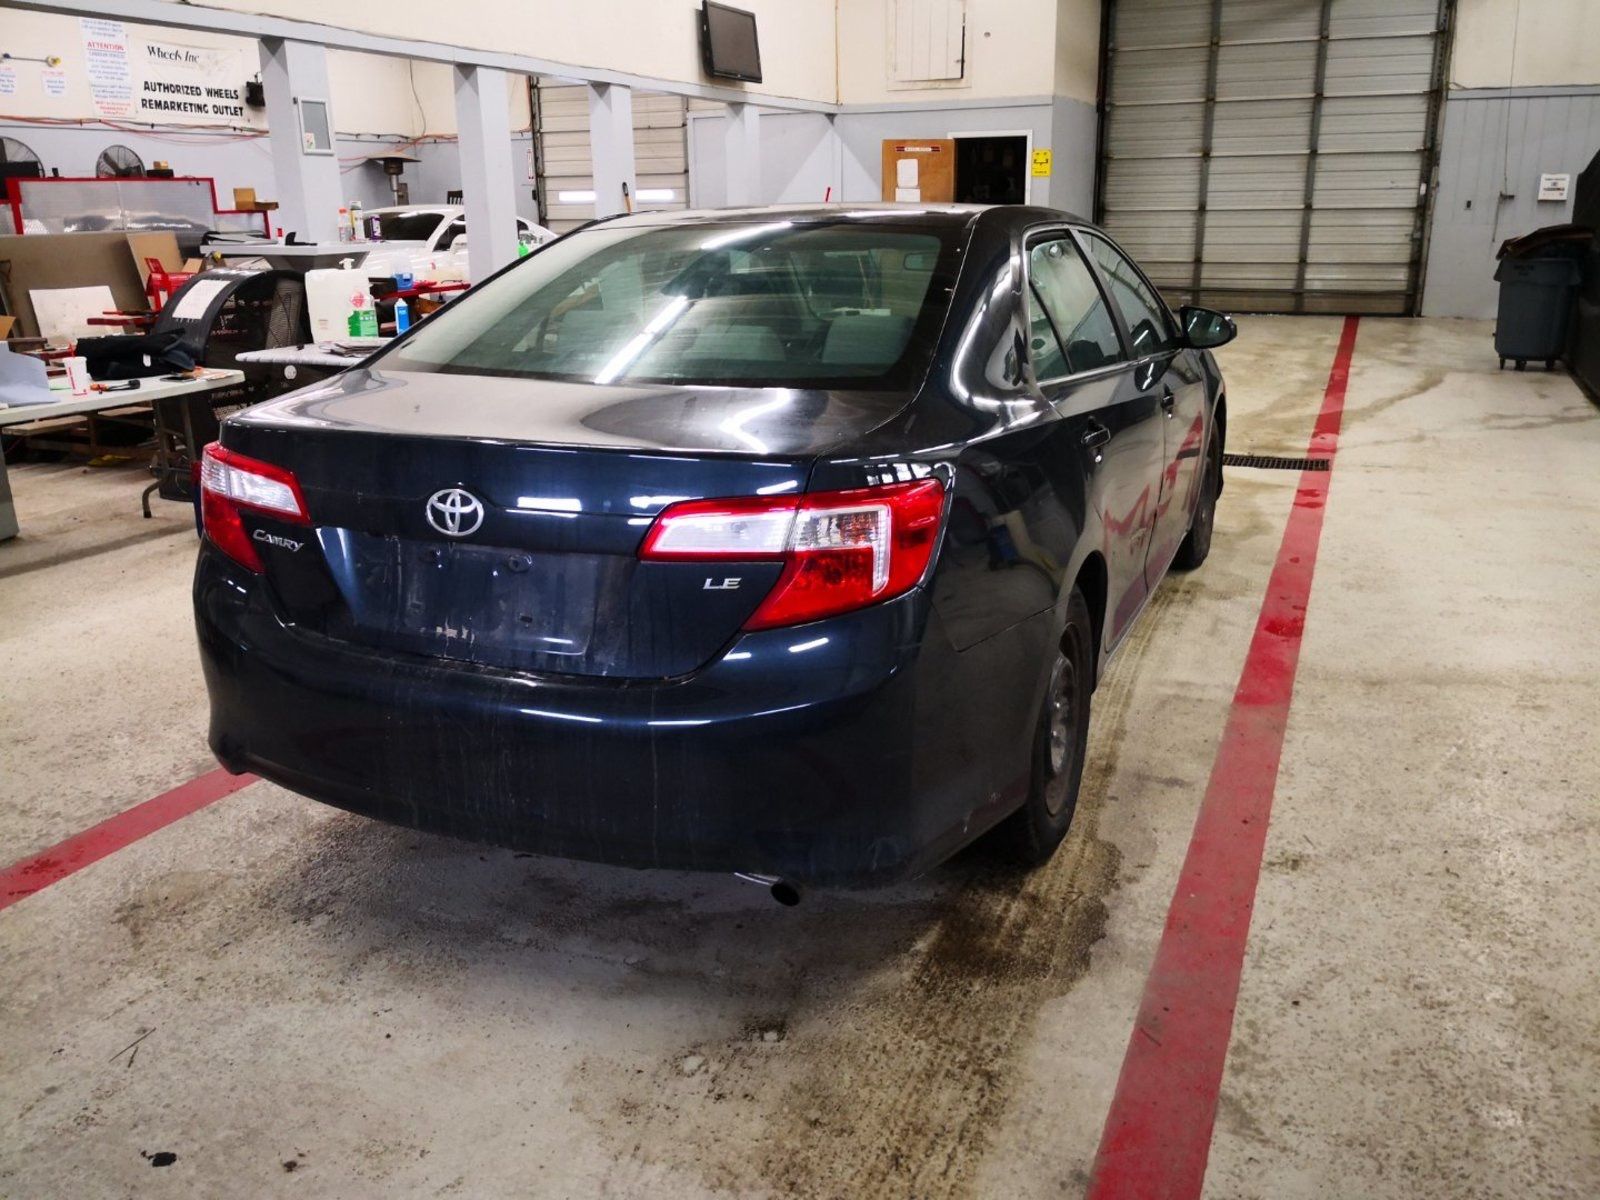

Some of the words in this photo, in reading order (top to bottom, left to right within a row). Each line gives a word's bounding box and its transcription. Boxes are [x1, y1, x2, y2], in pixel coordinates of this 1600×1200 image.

[87, 41, 124, 51] ATTENTION
[147, 45, 182, 61] Wheels
[144, 81, 202, 97] AUTHORIZED
[205, 87, 239, 100] WHEELS
[141, 99, 209, 114] REMARKETING
[212, 104, 244, 117] OUTLET
[252, 529, 305, 552] CAMRY
[702, 577, 742, 590] LE
